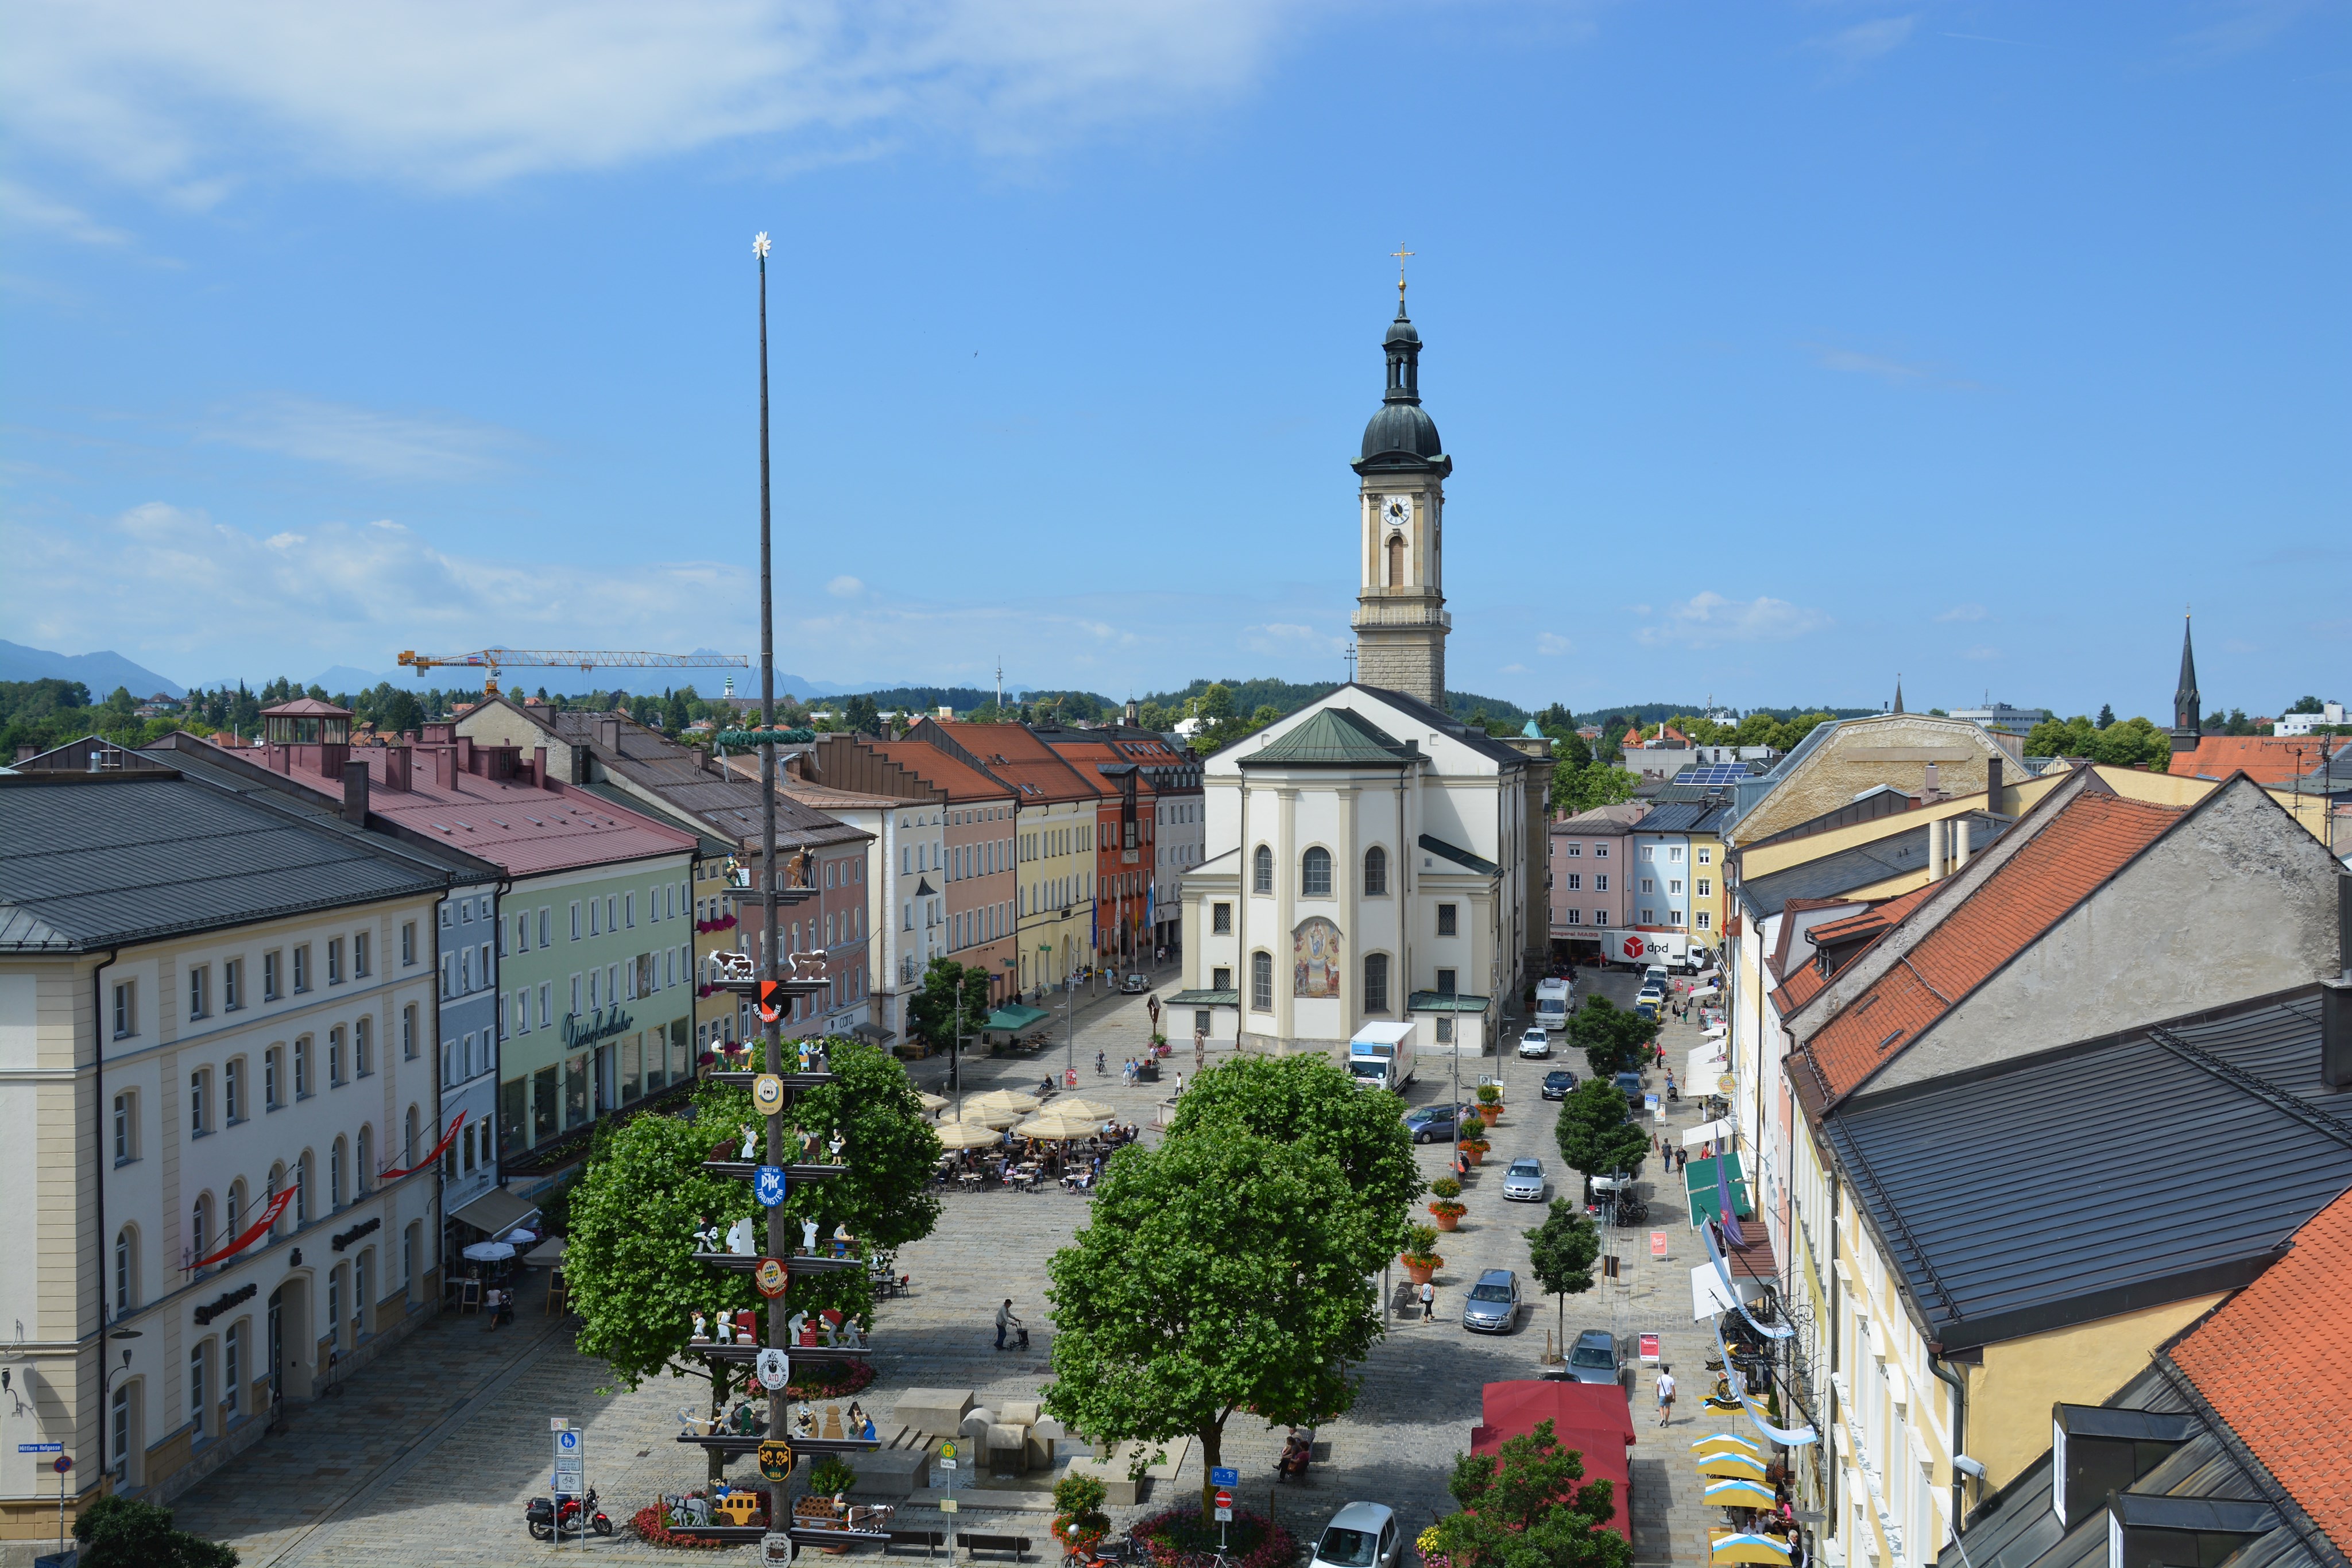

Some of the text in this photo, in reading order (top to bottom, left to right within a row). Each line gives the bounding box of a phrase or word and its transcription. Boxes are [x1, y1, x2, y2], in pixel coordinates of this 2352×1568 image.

[1647, 942, 1669, 955] dpd
[752, 1004, 782, 1021] KOLPINGFAMILIE
[561, 1006, 634, 1050] Unterforsthuber
[761, 1172, 780, 1191] DJK
[756, 1187, 783, 1205] TRAUNSTEIN
[332, 1217, 380, 1252] Sparkasse
[194, 1283, 257, 1326] Sparkasse
[768, 1351, 777, 1360] MSC
[759, 1361, 768, 1385] MOTORSPORT
[777, 1363, 786, 1373] CLUB
[768, 1374, 787, 1389] TRAUNSTEIN
[945, 1446, 951, 1455] H
